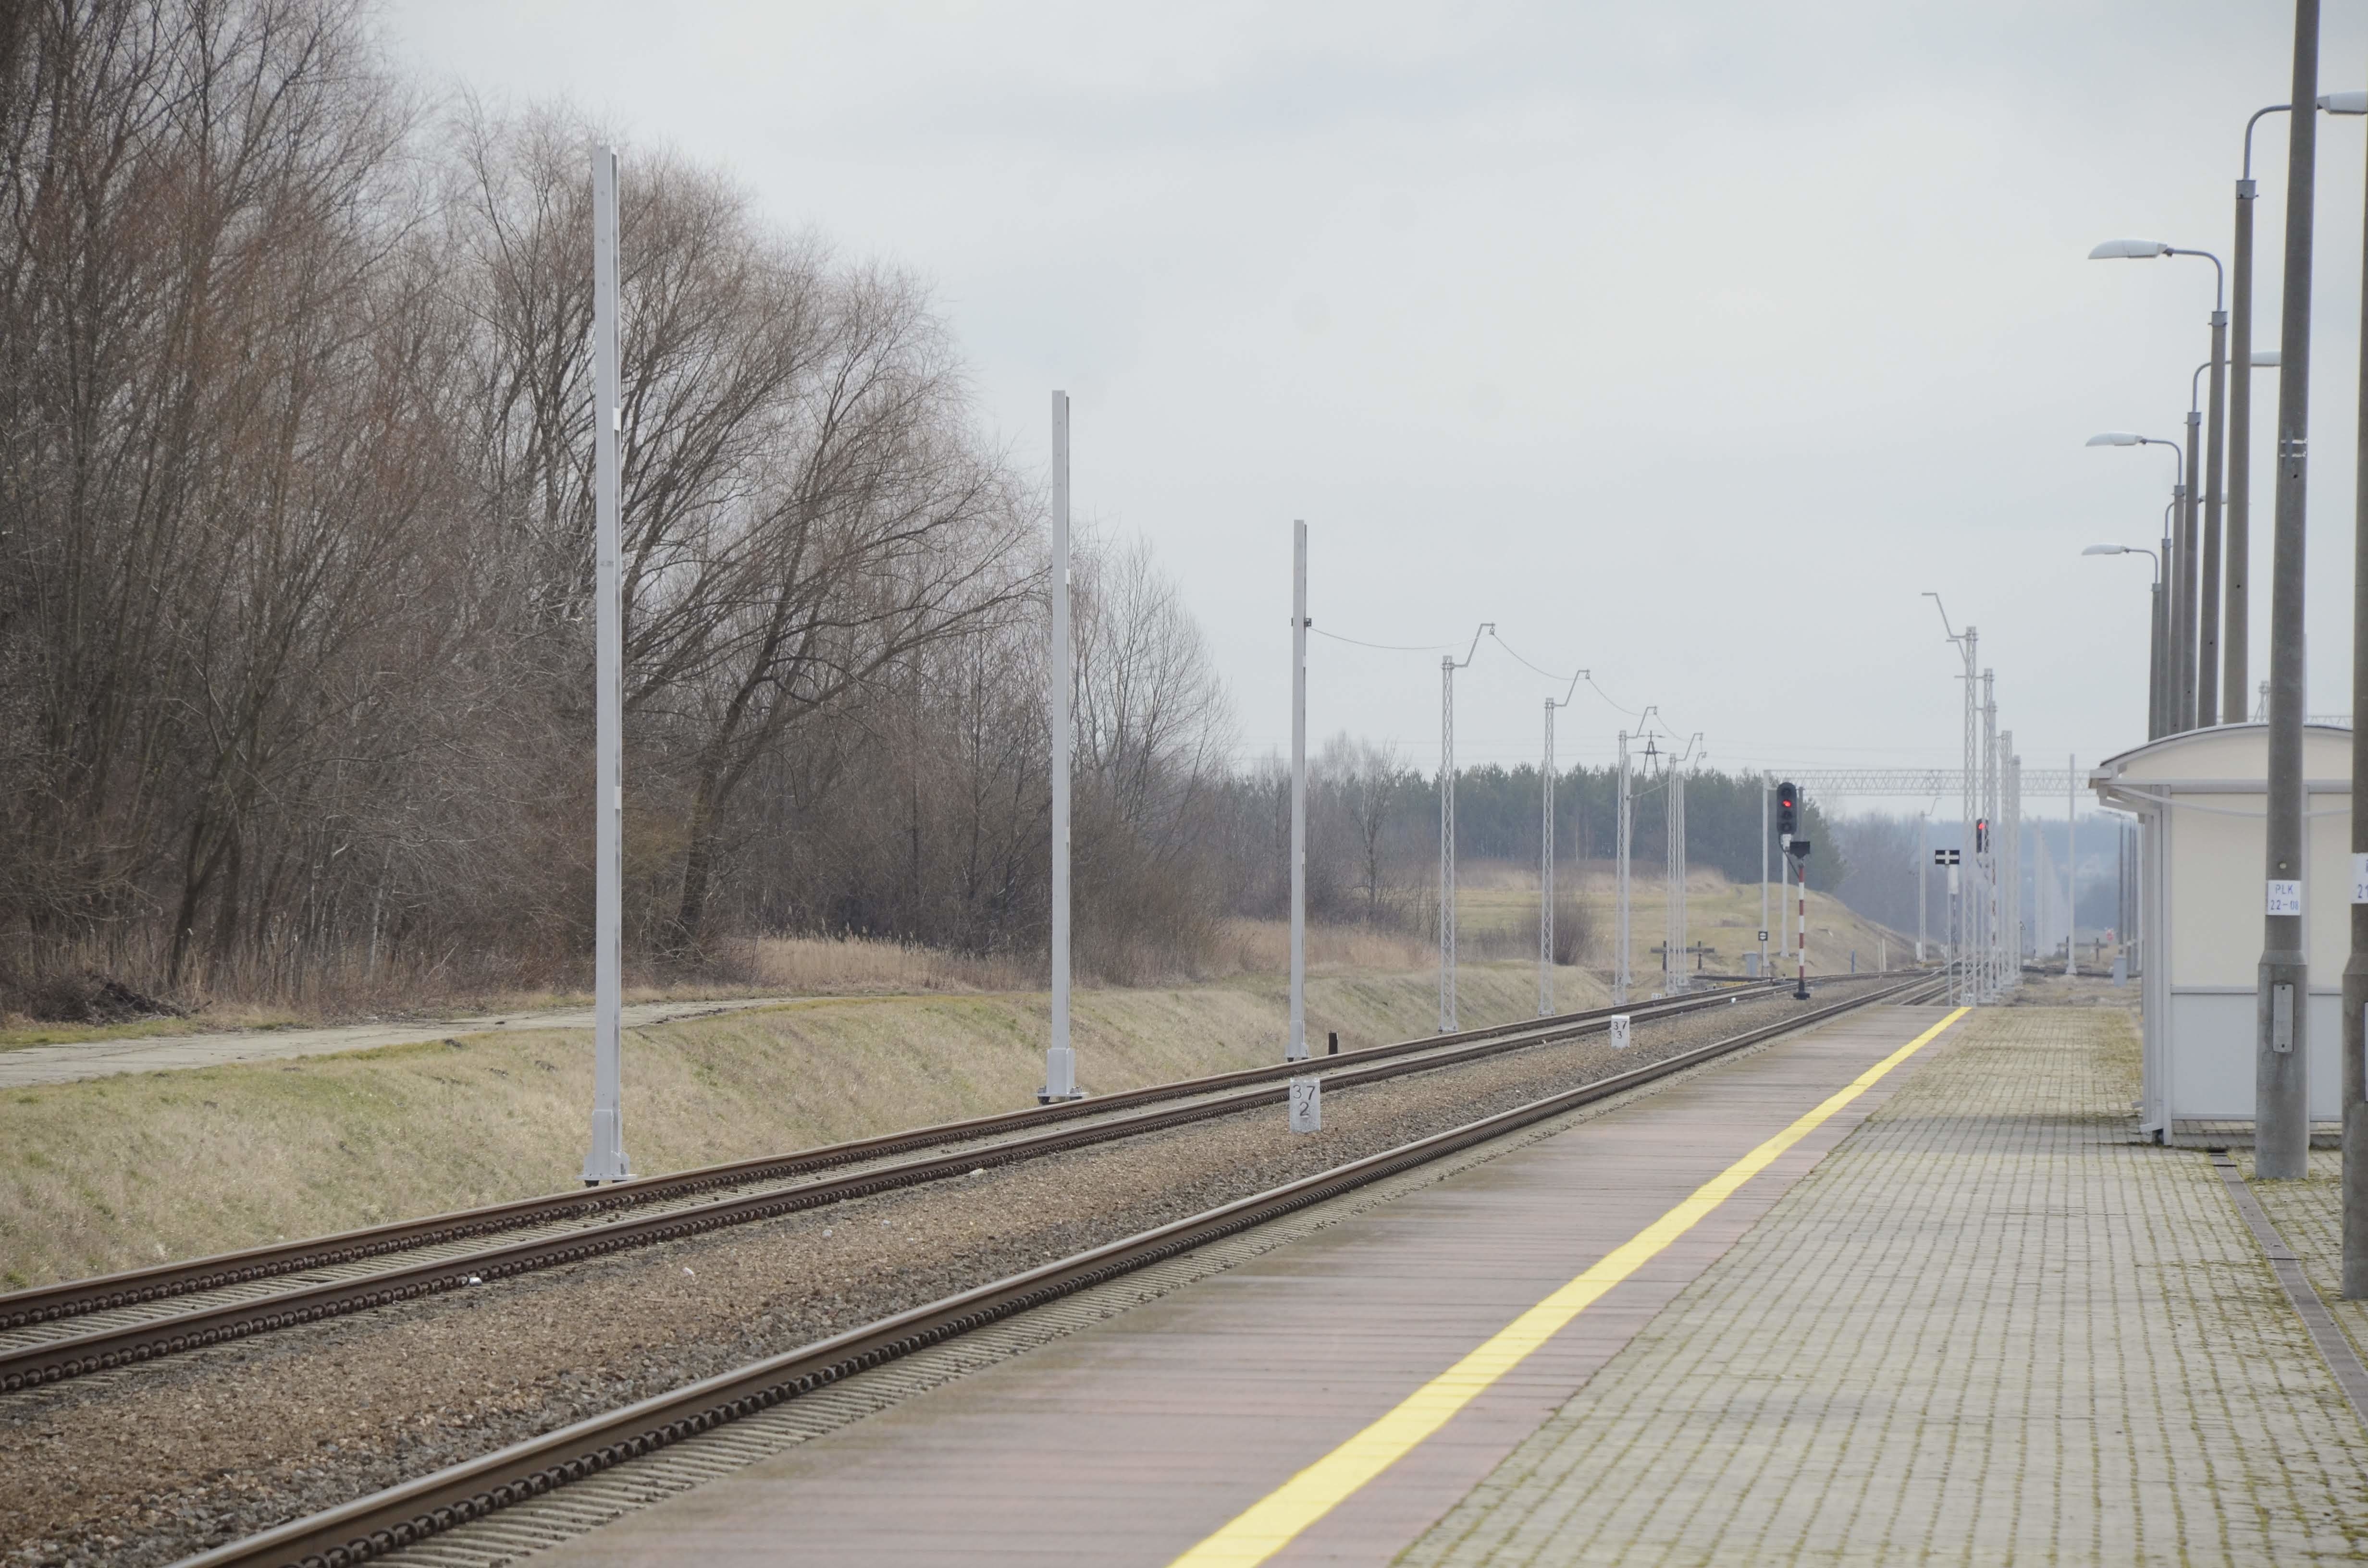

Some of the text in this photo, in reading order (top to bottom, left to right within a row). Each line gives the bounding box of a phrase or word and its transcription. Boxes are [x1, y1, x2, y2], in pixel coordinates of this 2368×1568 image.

[2276, 884, 2293, 894] PLK
[1613, 1021, 1628, 1030] 37
[1616, 1031, 1623, 1039] 3
[1293, 1084, 1316, 1101] 37
[1299, 1102, 1309, 1116] 2
